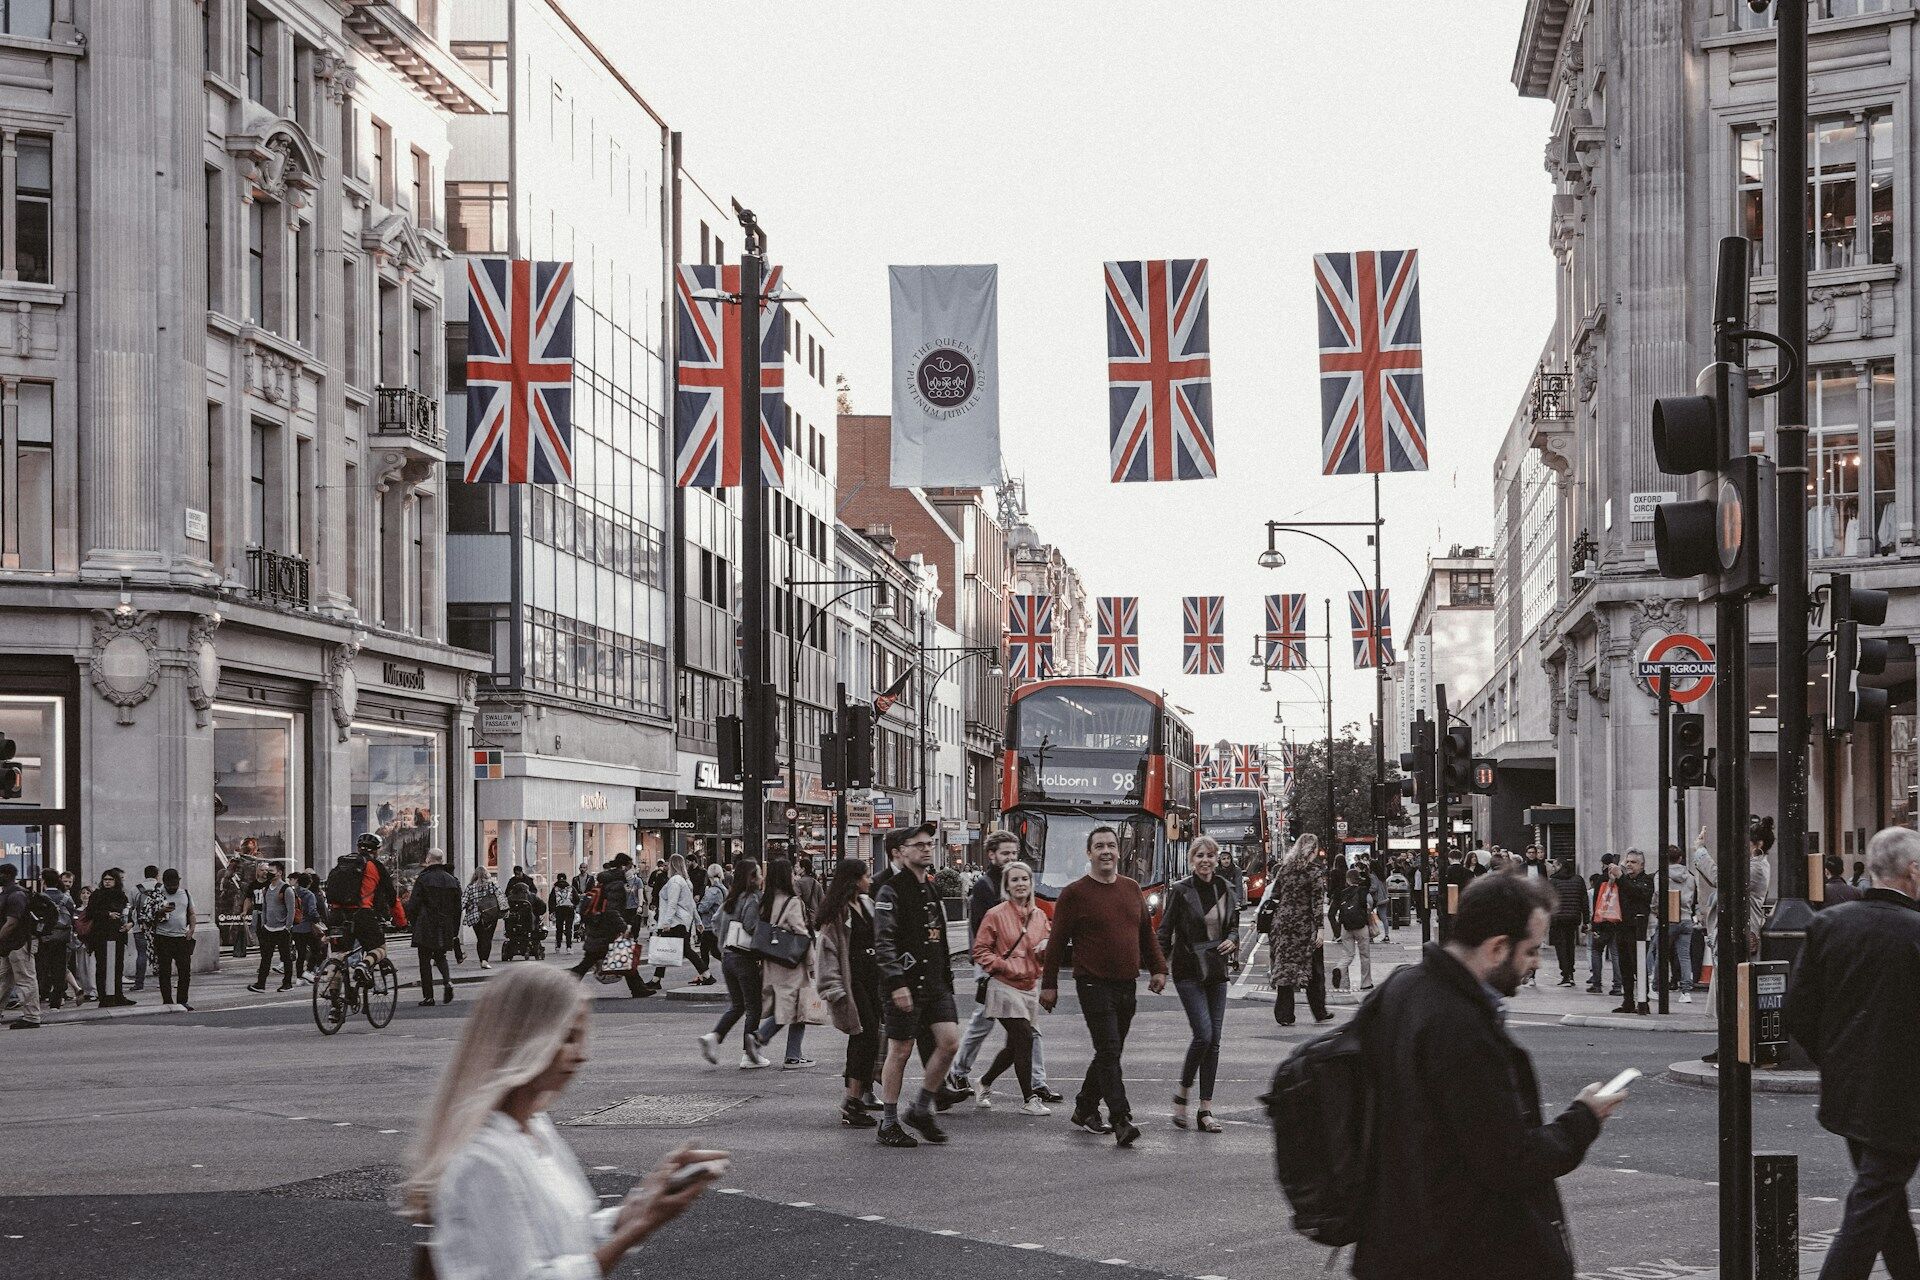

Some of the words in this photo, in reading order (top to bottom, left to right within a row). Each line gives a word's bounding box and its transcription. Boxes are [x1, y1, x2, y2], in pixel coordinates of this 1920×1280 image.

[1874, 214, 1891, 223] Sale
[912, 342, 932, 360] THE
[935, 338, 978, 360] QUEEN'S
[907, 370, 939, 417] PLATINUM
[943, 394, 980, 420] JUBILEE
[976, 370, 986, 391] 2022
[1419, 640, 1427, 668] JOHN
[383, 662, 425, 691] Microsoft
[1642, 664, 1717, 674] UNDRGROUND
[1419, 672, 1427, 704] LEWIS
[1036, 774, 1089, 787] Holborn
[1111, 773, 1135, 791] 98
[1244, 826, 1255, 834] 55
[1759, 995, 1782, 1009] WAIT
